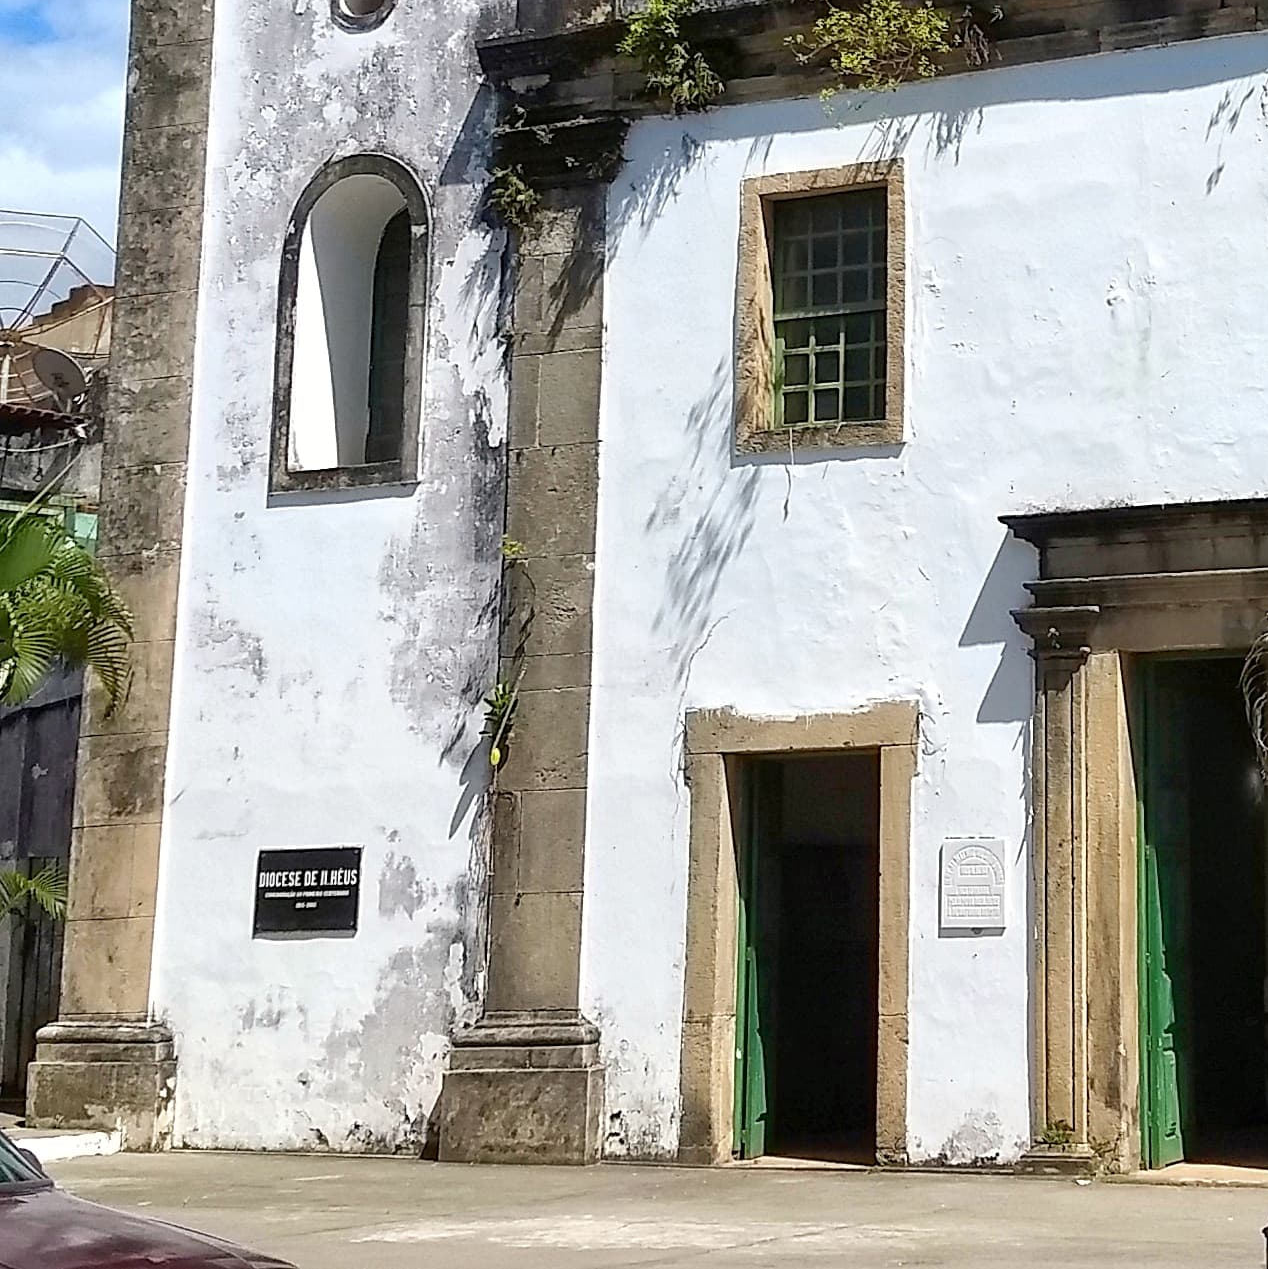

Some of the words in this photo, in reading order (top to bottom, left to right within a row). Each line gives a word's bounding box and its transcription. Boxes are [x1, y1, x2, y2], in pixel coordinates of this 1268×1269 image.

[258, 870, 303, 888] DIOCESE
[304, 870, 319, 887] DE
[320, 867, 358, 886] ILHÉUS
